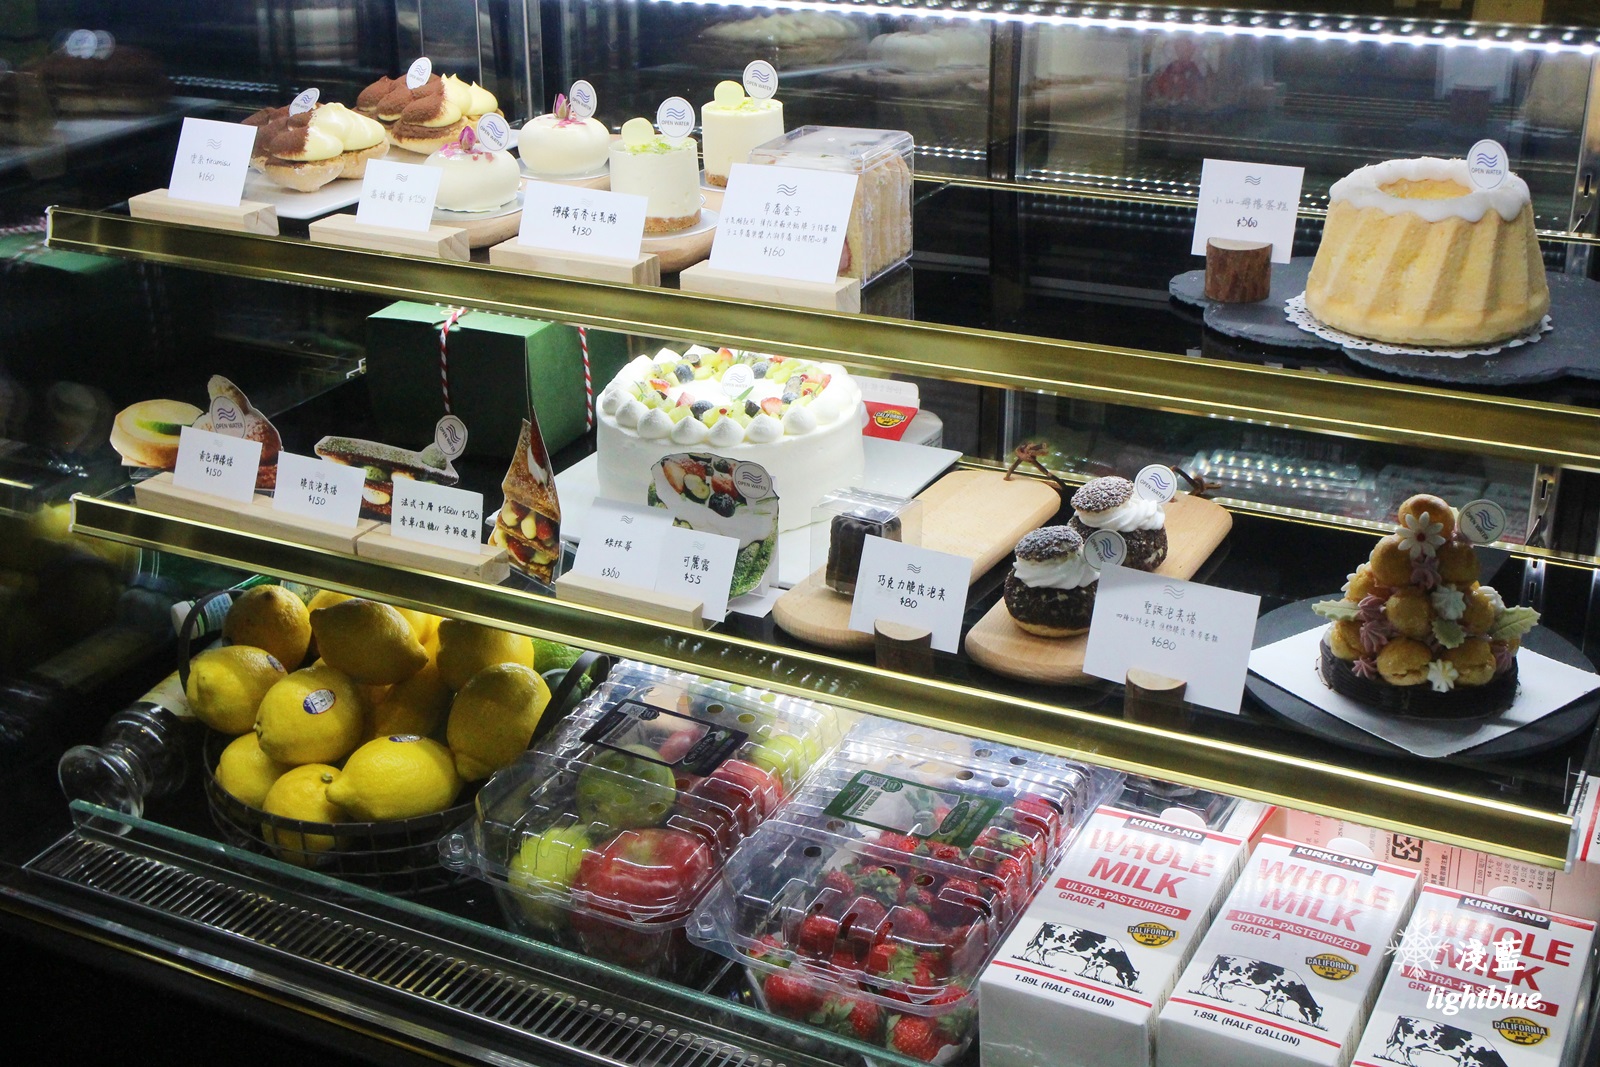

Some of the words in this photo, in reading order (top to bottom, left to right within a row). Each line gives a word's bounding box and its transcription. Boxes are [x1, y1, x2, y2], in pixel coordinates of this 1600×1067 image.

[745, 80, 758, 88] OPEN
[758, 82, 772, 91] WATER
[479, 125, 490, 137] OPEN
[489, 134, 503, 147] WATER
[198, 171, 215, 182] $160
[571, 225, 592, 236] $130
[1237, 216, 1258, 228] $360
[763, 246, 786, 257] $160
[205, 466, 222, 477] $150
[751, 483, 766, 491] WATER
[1139, 478, 1152, 489] OPEN
[1151, 487, 1166, 500] WATER
[308, 494, 326, 505] $150
[1465, 511, 1476, 525] OPEN
[1475, 523, 1489, 540] WATER
[601, 567, 620, 579] $360
[684, 573, 702, 585] $55
[900, 596, 918, 609] $80
[1151, 637, 1177, 651] $680
[1130, 817, 1204, 840] KIRKLAND
[1089, 828, 1217, 877] WHOLE
[1296, 846, 1374, 871] KIRKLAND
[1087, 857, 1188, 899] MILK
[1258, 858, 1395, 911] WHOLE
[1058, 891, 1095, 907] GRADE
[1096, 900, 1105, 909] A
[1065, 881, 1181, 918] ULTRA-PASTEURIZED
[1260, 888, 1362, 932] MILK
[1464, 897, 1548, 924] KIRKLAND
[1129, 926, 1176, 938] CALIFORNIA
[1231, 923, 1270, 938] GRADE
[1272, 932, 1281, 941] A
[1237, 913, 1360, 951] ULTRA-PASTEURIZED
[1427, 907, 1574, 967] WHOLE
[1306, 957, 1356, 972] CALIFORNIA
[1014, 974, 1039, 987] 1.89L
[1041, 980, 1071, 995] (HALF
[1072, 988, 1115, 1008] GALLON)
[1193, 1009, 1219, 1023] 1.89L
[1221, 1016, 1252, 1031] (HALF
[1255, 1026, 1300, 1046] GALLON)
[1493, 1020, 1547, 1036] CALIFORNIA
